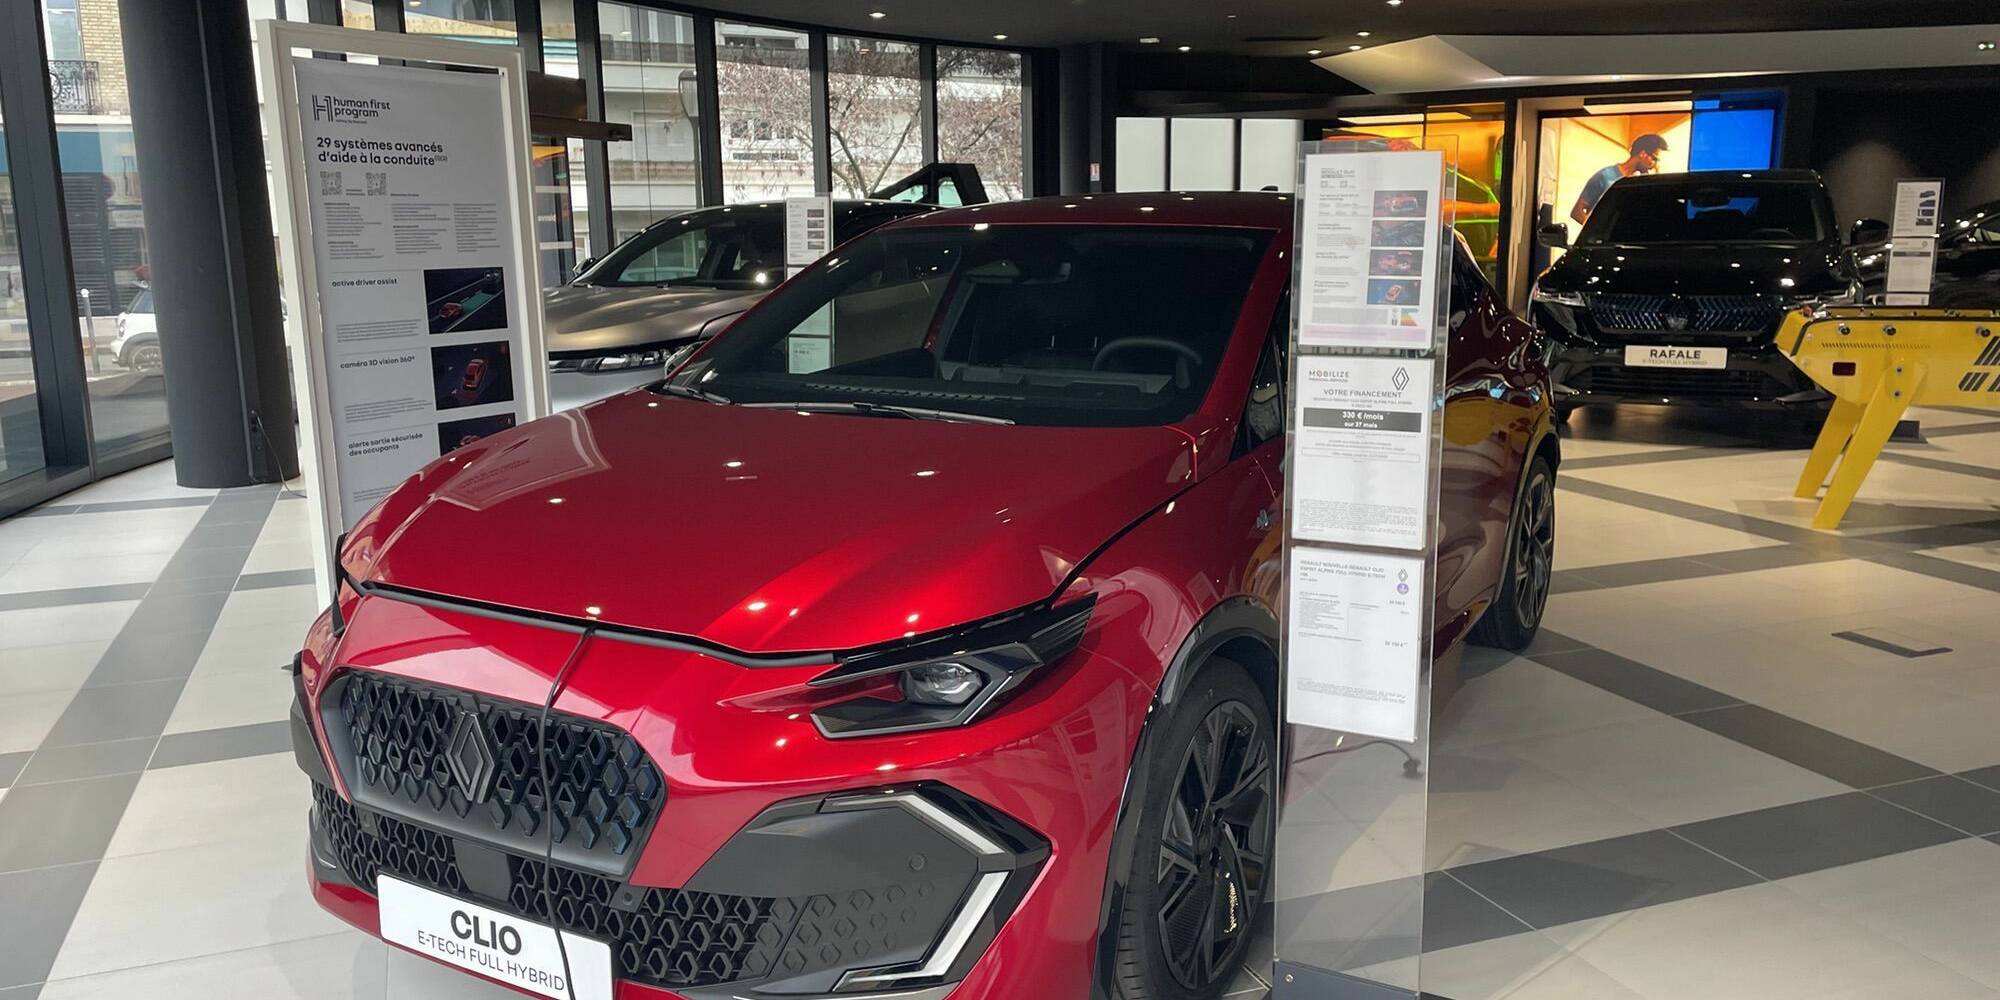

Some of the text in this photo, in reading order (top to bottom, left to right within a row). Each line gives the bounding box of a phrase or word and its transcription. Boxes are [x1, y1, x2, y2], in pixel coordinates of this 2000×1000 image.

[333, 97, 391, 110] human first
[334, 107, 379, 118] program
[317, 137, 443, 153] 29 systèmes avancés
[319, 151, 357, 163] d'aide
[360, 152, 367, 163] à
[370, 153, 381, 164] la
[1649, 349, 1702, 360] RAFALE
[340, 360, 368, 369] caméra
[1309, 369, 1350, 378] MOBILIZE
[1323, 389, 1402, 399] VOTRE FINANCEMENT
[348, 432, 423, 449] alerte sortie sécurisée
[363, 444, 399, 455] occupants
[450, 910, 522, 956] CLIO
[417, 929, 565, 992] E-TECH FULL HYBRID
